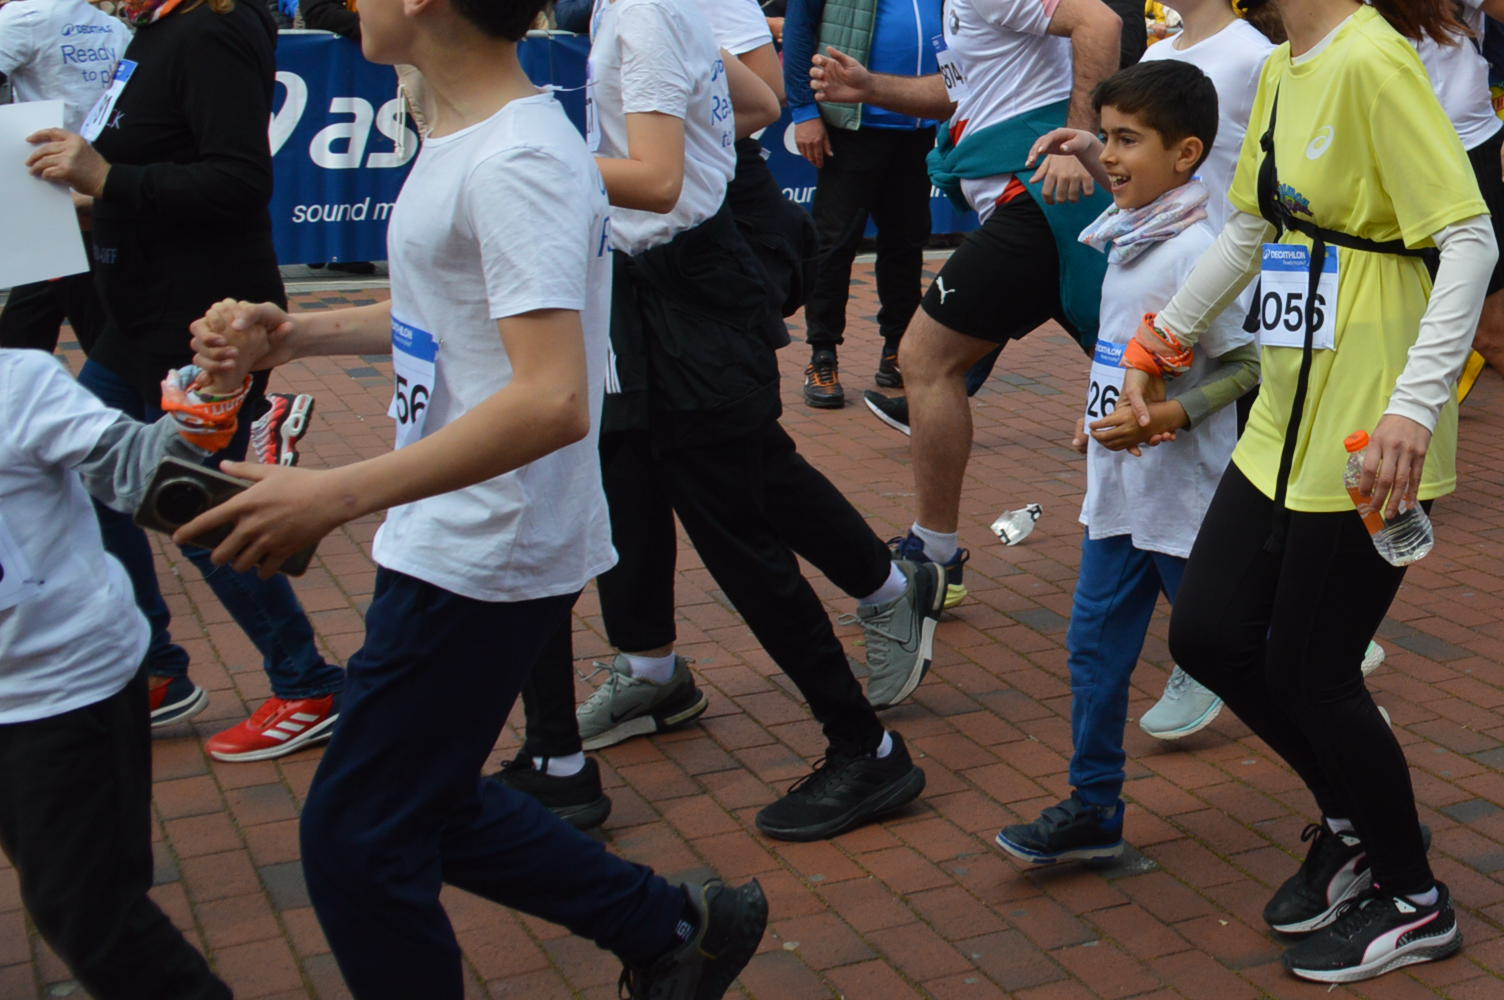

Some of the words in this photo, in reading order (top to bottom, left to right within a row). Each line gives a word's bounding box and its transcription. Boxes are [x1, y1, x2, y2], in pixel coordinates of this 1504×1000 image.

[61, 44, 116, 65] Ready
[82, 68, 97, 82] to
[292, 197, 371, 223] sound
[1270, 249, 1306, 260] DECATHLON
